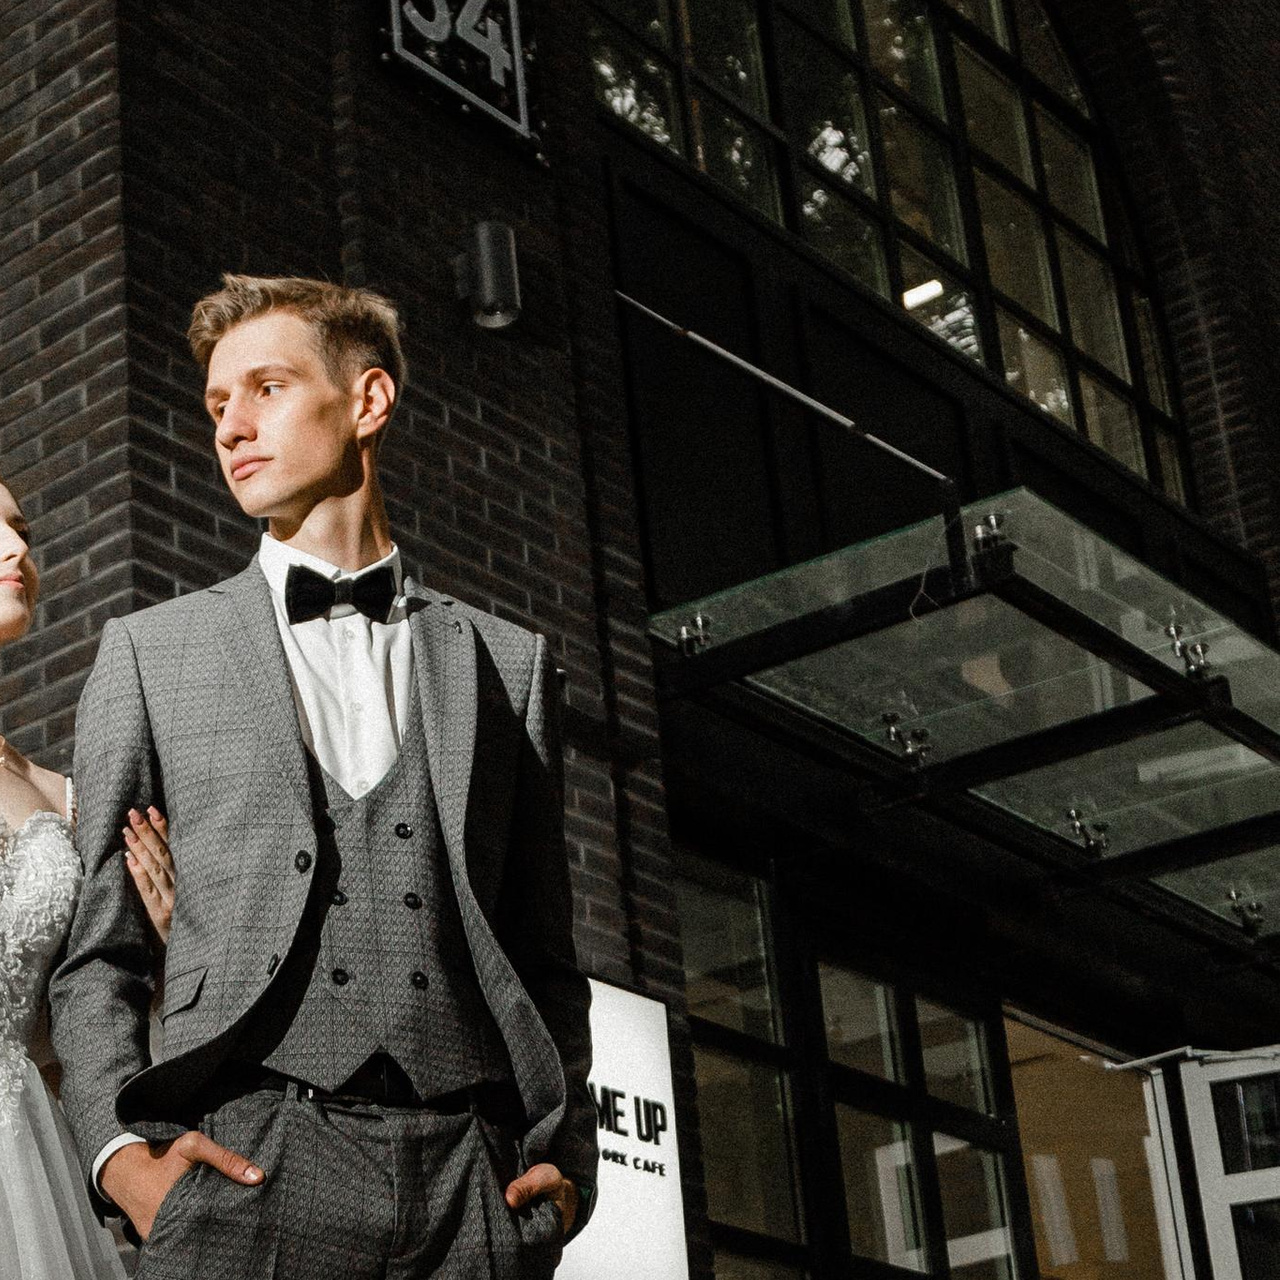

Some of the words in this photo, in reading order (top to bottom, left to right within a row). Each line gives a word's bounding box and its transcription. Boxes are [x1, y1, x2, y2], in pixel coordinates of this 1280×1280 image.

[634, 1095, 667, 1146] UP
[600, 1148, 628, 1167] ORK
[633, 1157, 666, 1177] CAFE
